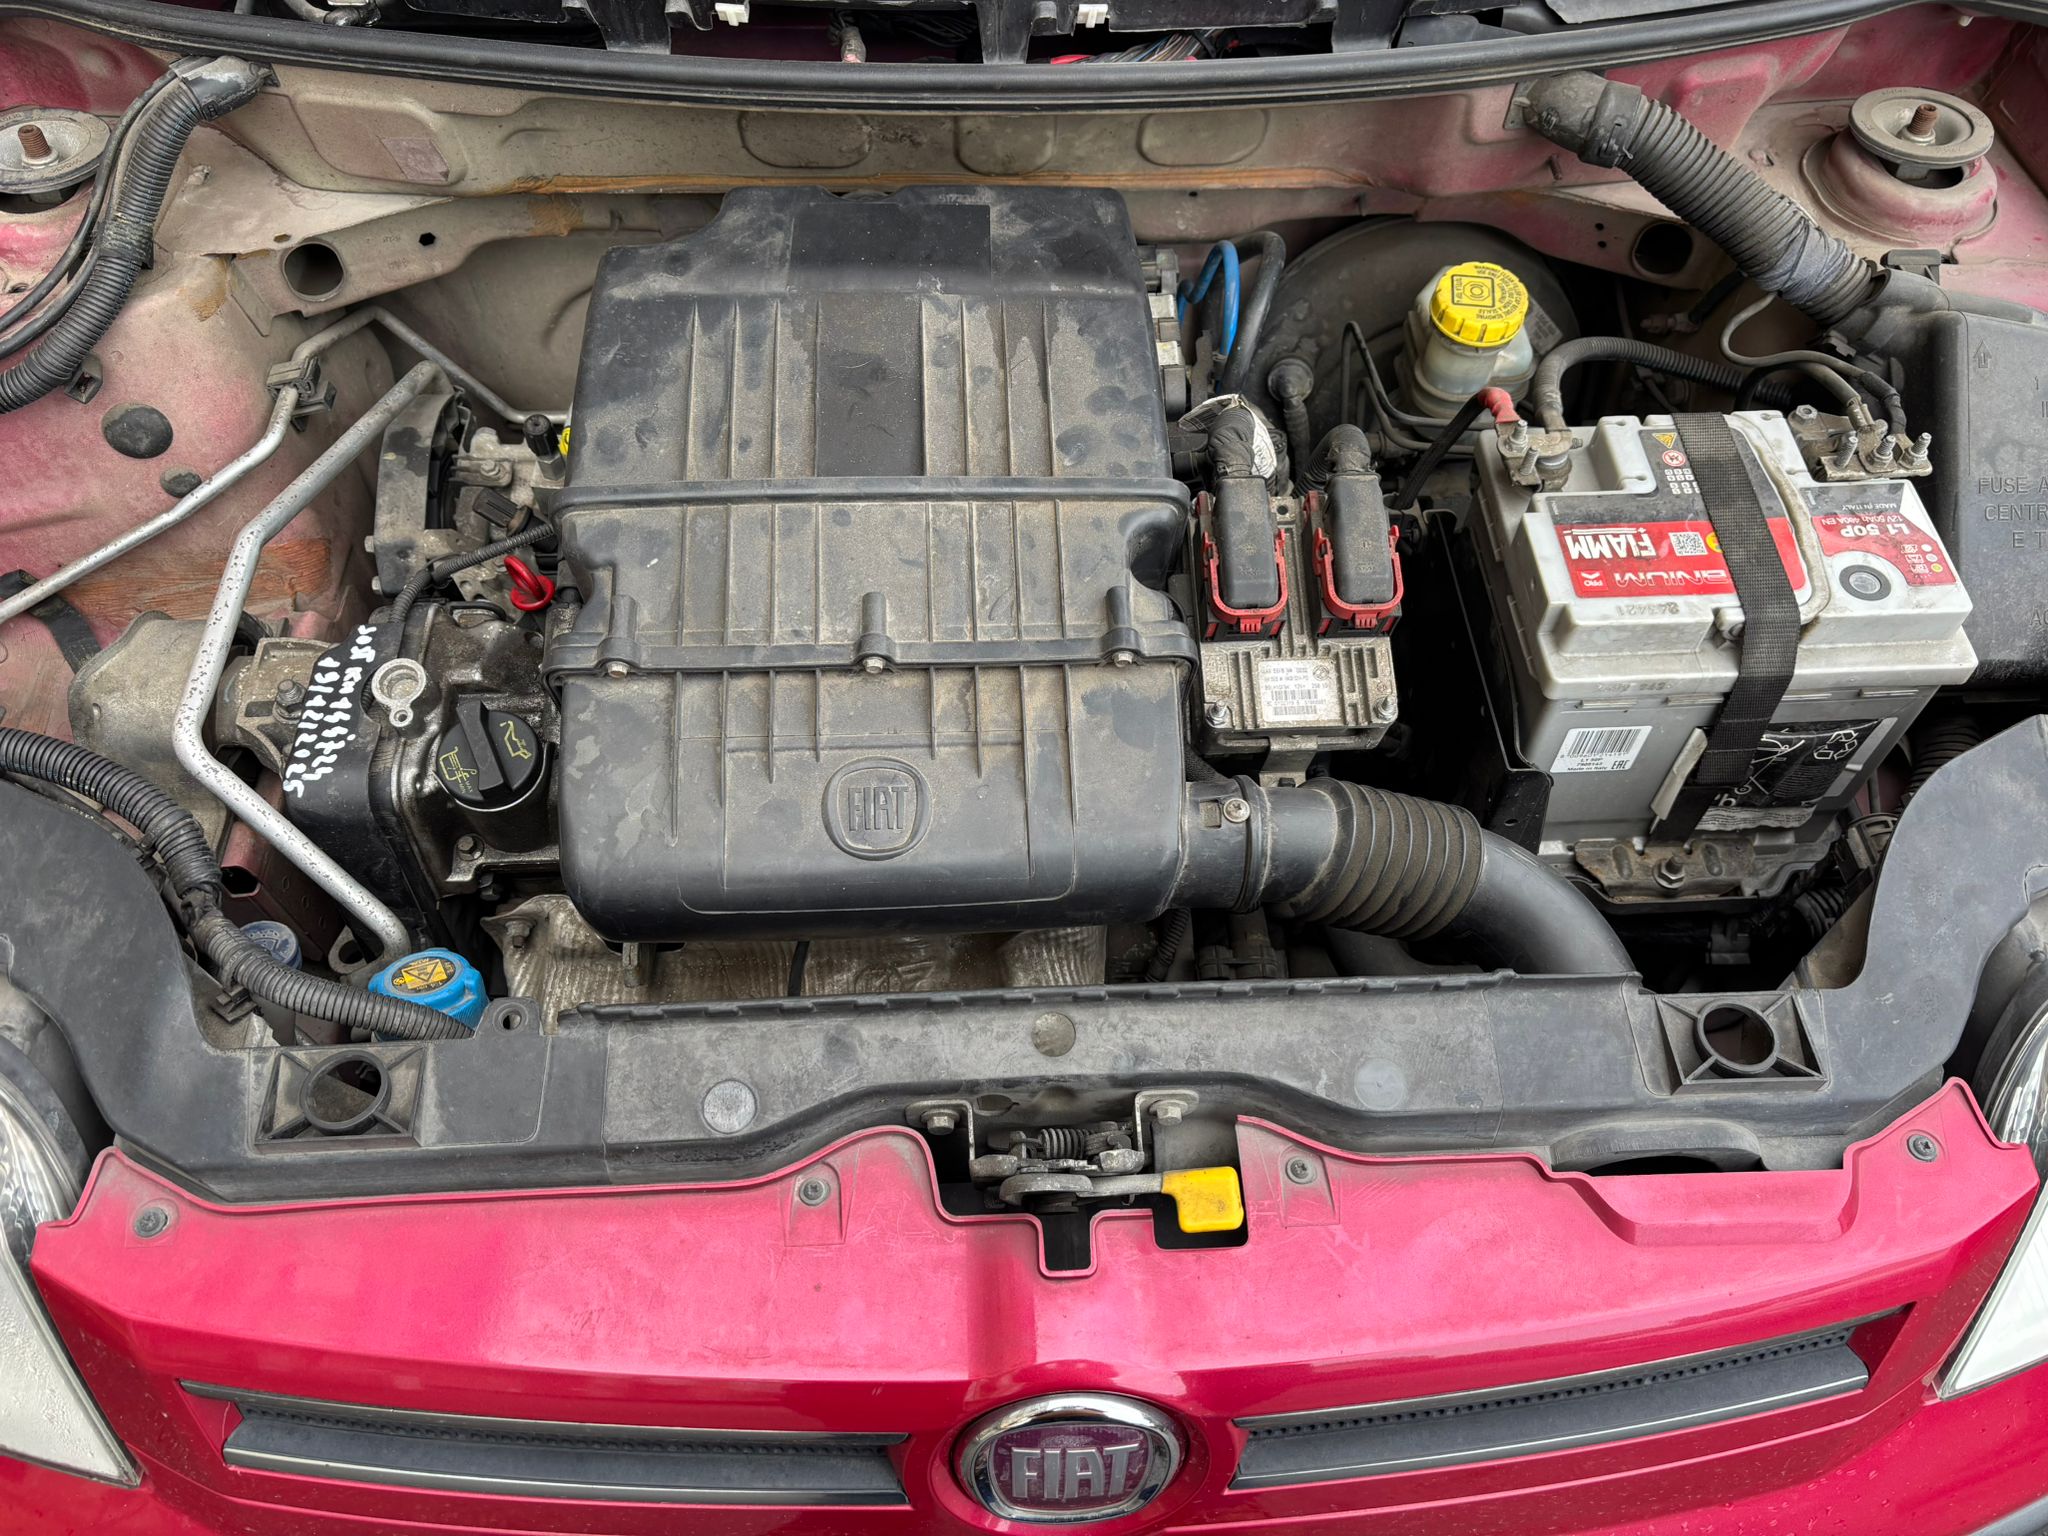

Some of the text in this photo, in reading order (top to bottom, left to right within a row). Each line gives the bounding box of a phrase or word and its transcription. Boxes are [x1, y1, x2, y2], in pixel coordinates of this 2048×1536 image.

[1978, 475, 2029, 495] FUSE
[1841, 503, 1862, 511] ITALY
[1873, 502, 1897, 510] MADE
[1821, 517, 1837, 526] EN
[1840, 523, 1911, 538] L1 50P
[1564, 533, 1657, 560] FIAMM
[1583, 579, 1604, 587] PRO
[847, 785, 909, 833] FIAT
[1011, 1442, 1141, 1500] FIAT
